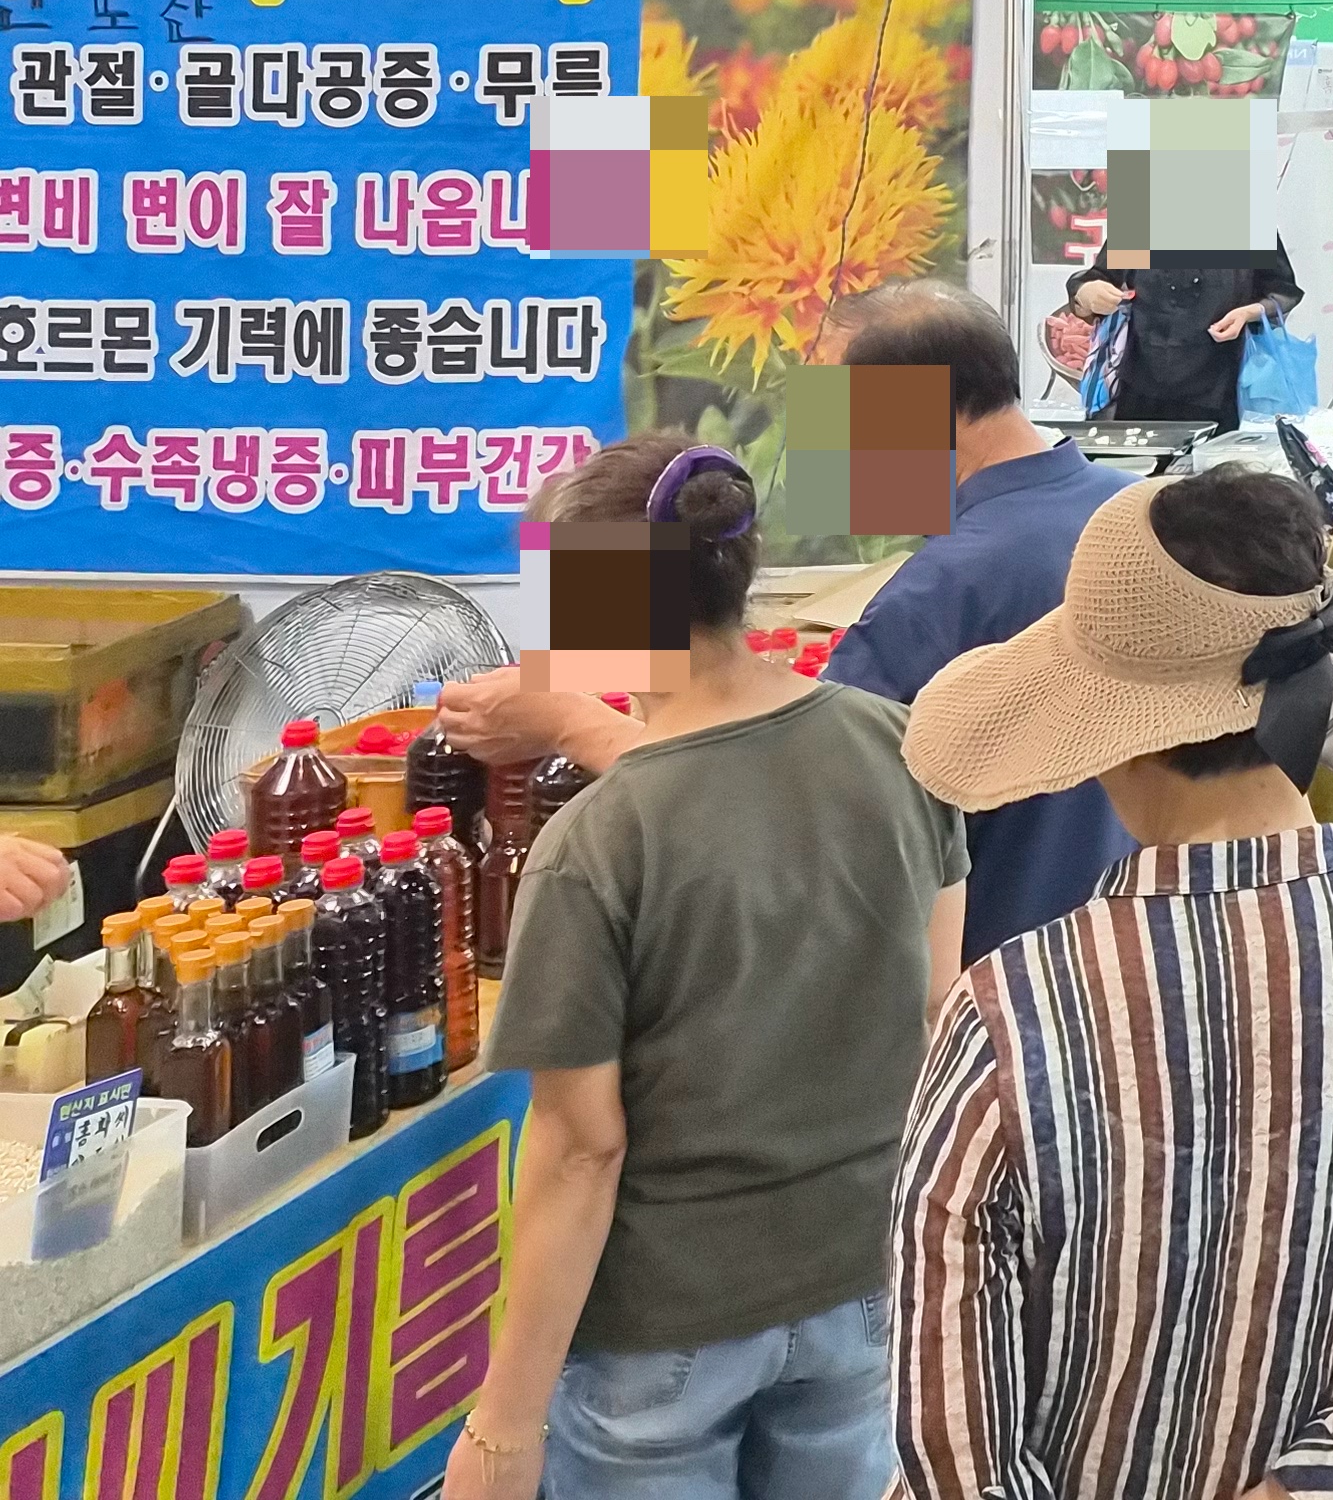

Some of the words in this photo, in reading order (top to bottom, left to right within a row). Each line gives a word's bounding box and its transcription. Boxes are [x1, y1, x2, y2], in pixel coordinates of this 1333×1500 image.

[126, 172, 245, 252] 변이
[268, 173, 335, 253] 잘
[357, 172, 531, 253] 나옵니
[0, 300, 156, 381] 호르몬
[173, 300, 348, 382] 기력에
[366, 300, 605, 382] 좋습니다
